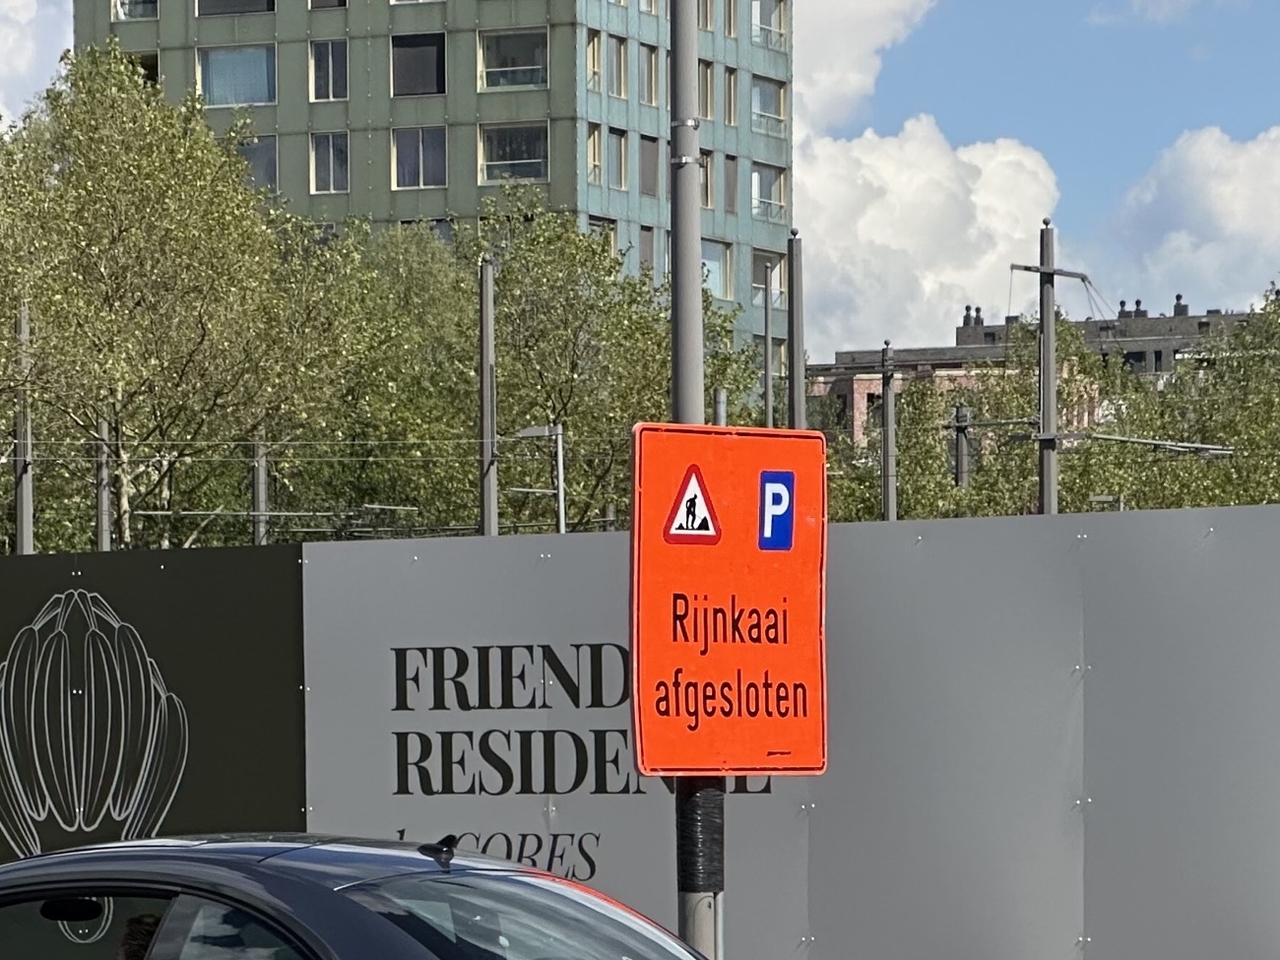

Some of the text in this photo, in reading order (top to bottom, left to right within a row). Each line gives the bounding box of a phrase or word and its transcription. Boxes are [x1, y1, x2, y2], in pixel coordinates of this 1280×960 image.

[763, 482, 790, 538] P
[672, 593, 788, 656] Rijnkaai
[389, 643, 632, 712] FRIEND
[655, 668, 808, 732] afgesloten
[391, 729, 772, 797] RESIDE
